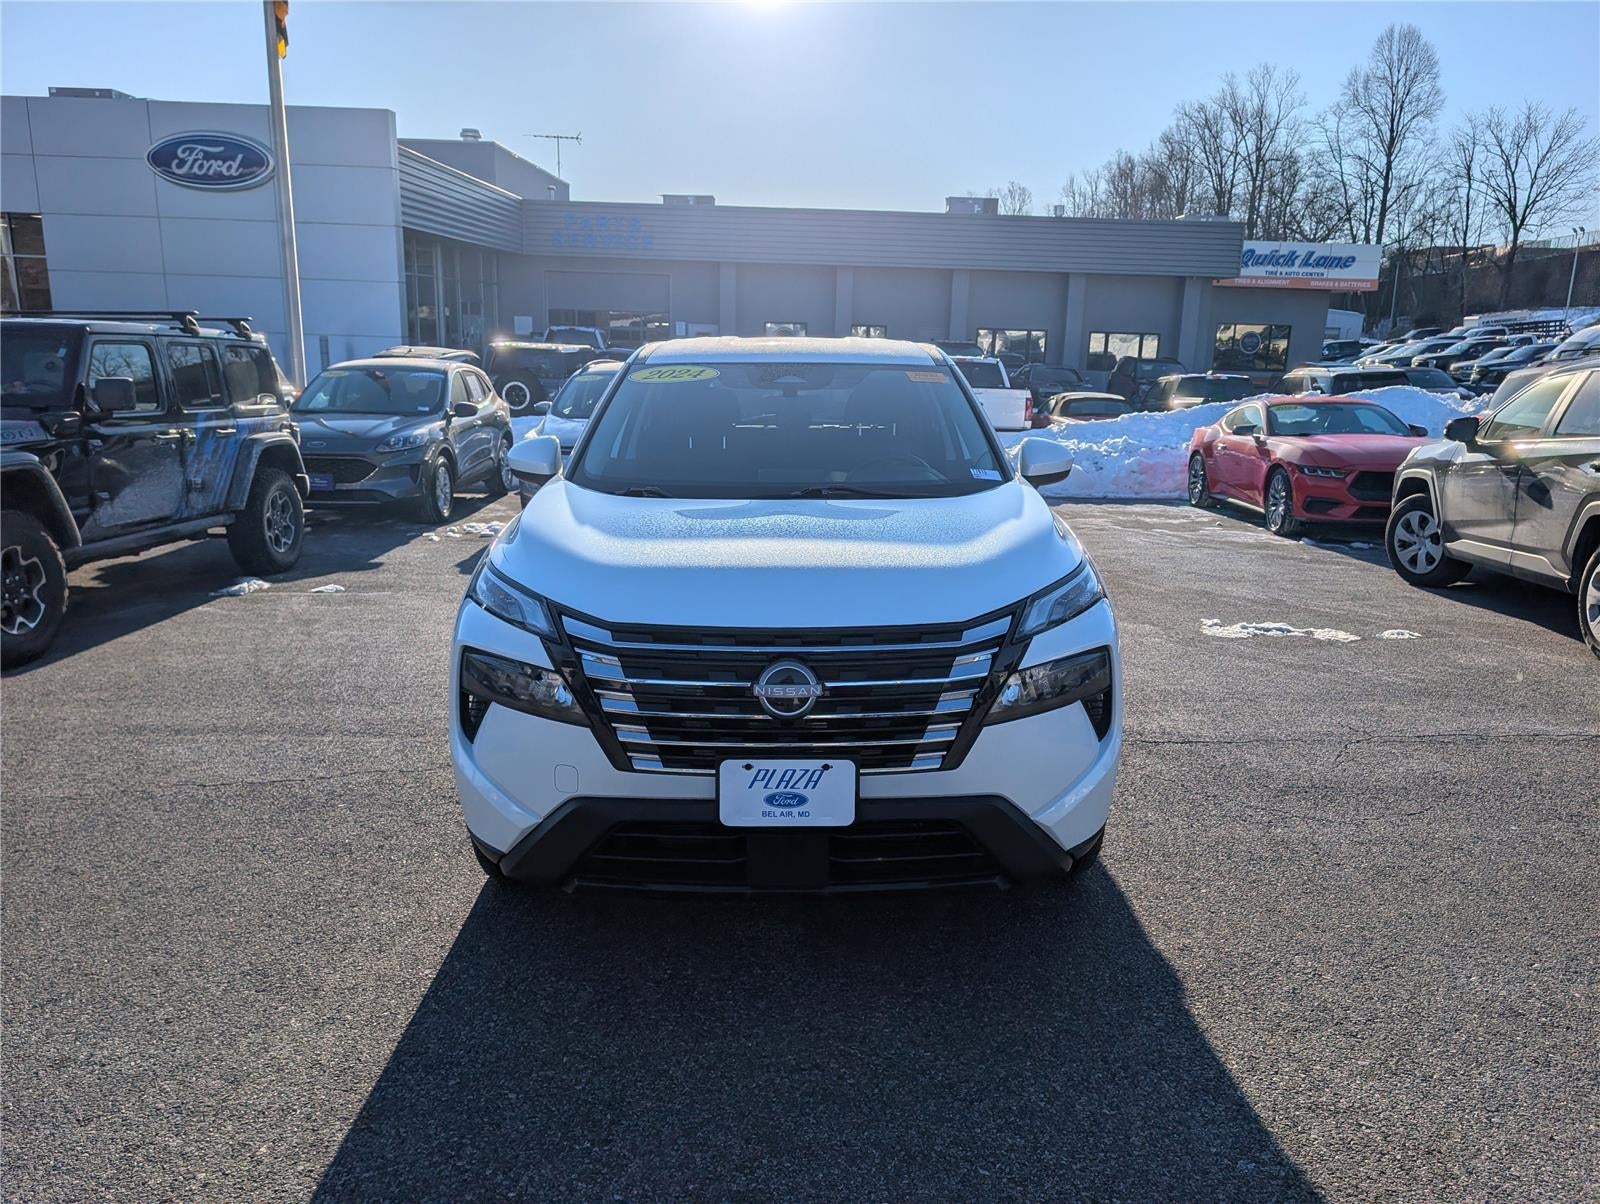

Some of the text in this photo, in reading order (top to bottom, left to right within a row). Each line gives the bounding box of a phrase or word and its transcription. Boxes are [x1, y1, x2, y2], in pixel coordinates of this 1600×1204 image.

[171, 143, 243, 176] Ford
[1241, 248, 1356, 269] Quick Lane
[642, 368, 707, 380] 2024
[755, 687, 822, 696] NISSAN
[748, 768, 825, 790] PLAZA
[773, 794, 800, 805] Ford
